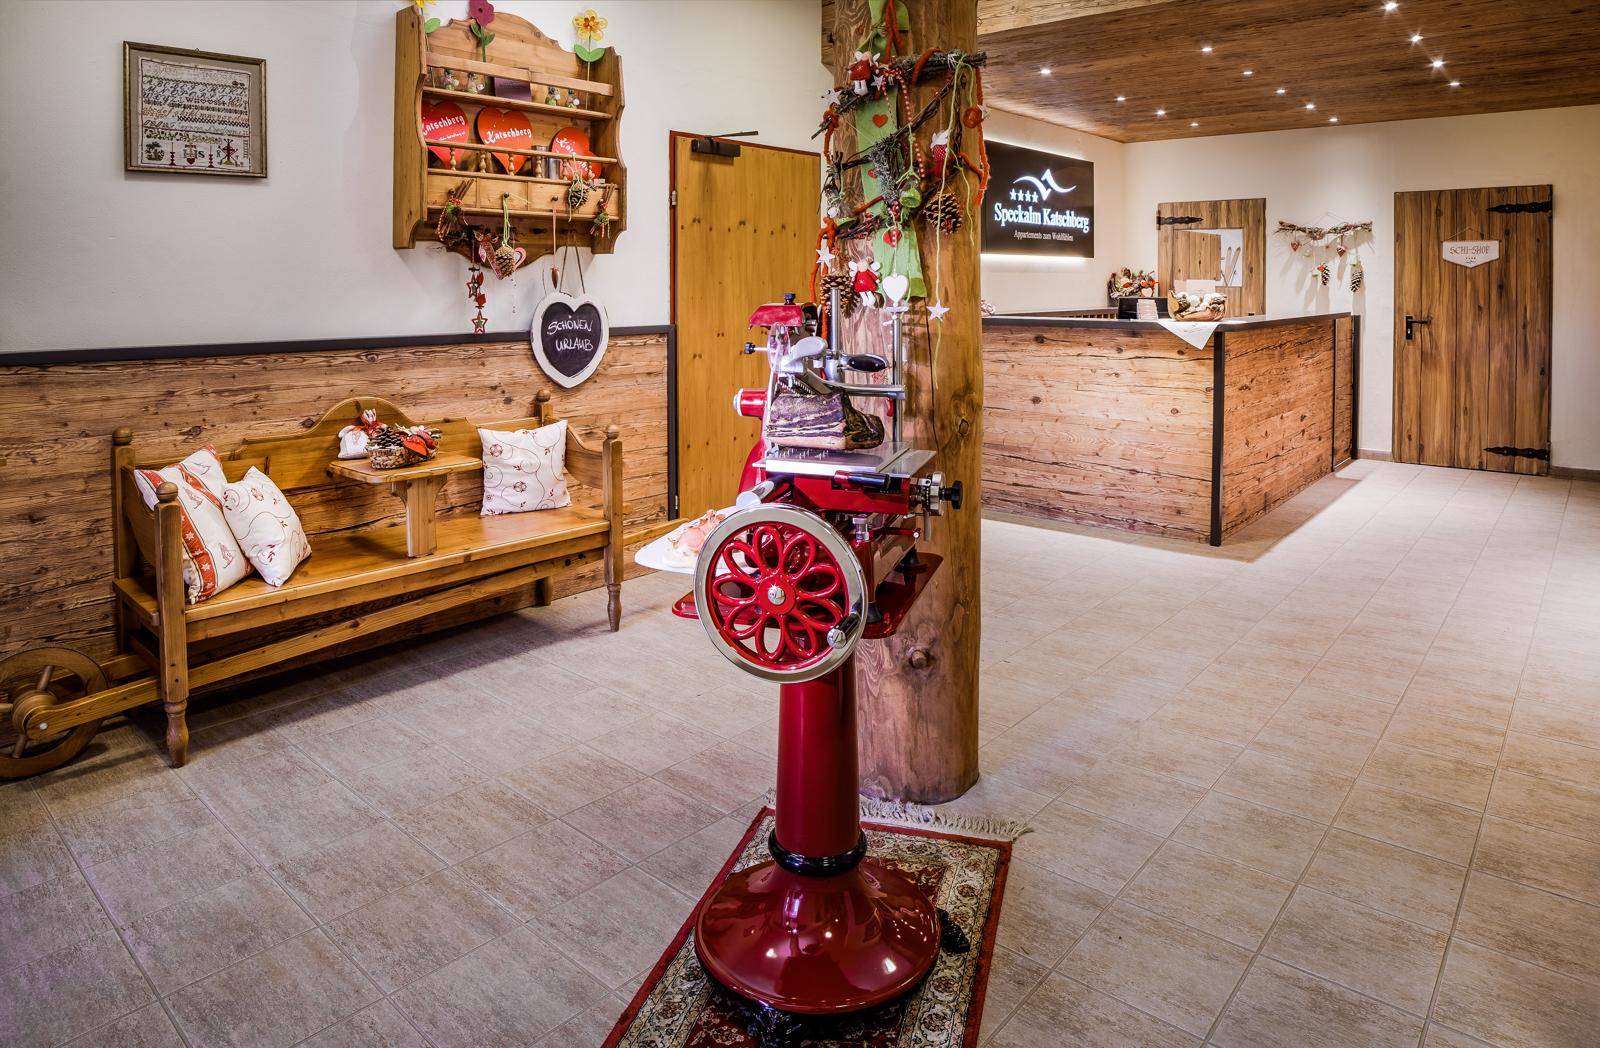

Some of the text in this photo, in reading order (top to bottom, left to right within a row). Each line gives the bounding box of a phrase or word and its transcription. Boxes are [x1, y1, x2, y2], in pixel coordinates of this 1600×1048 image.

[484, 127, 532, 144] Katschberg
[995, 203, 1089, 233] Speckalm Katschberg
[555, 337, 594, 352] URLAUB
